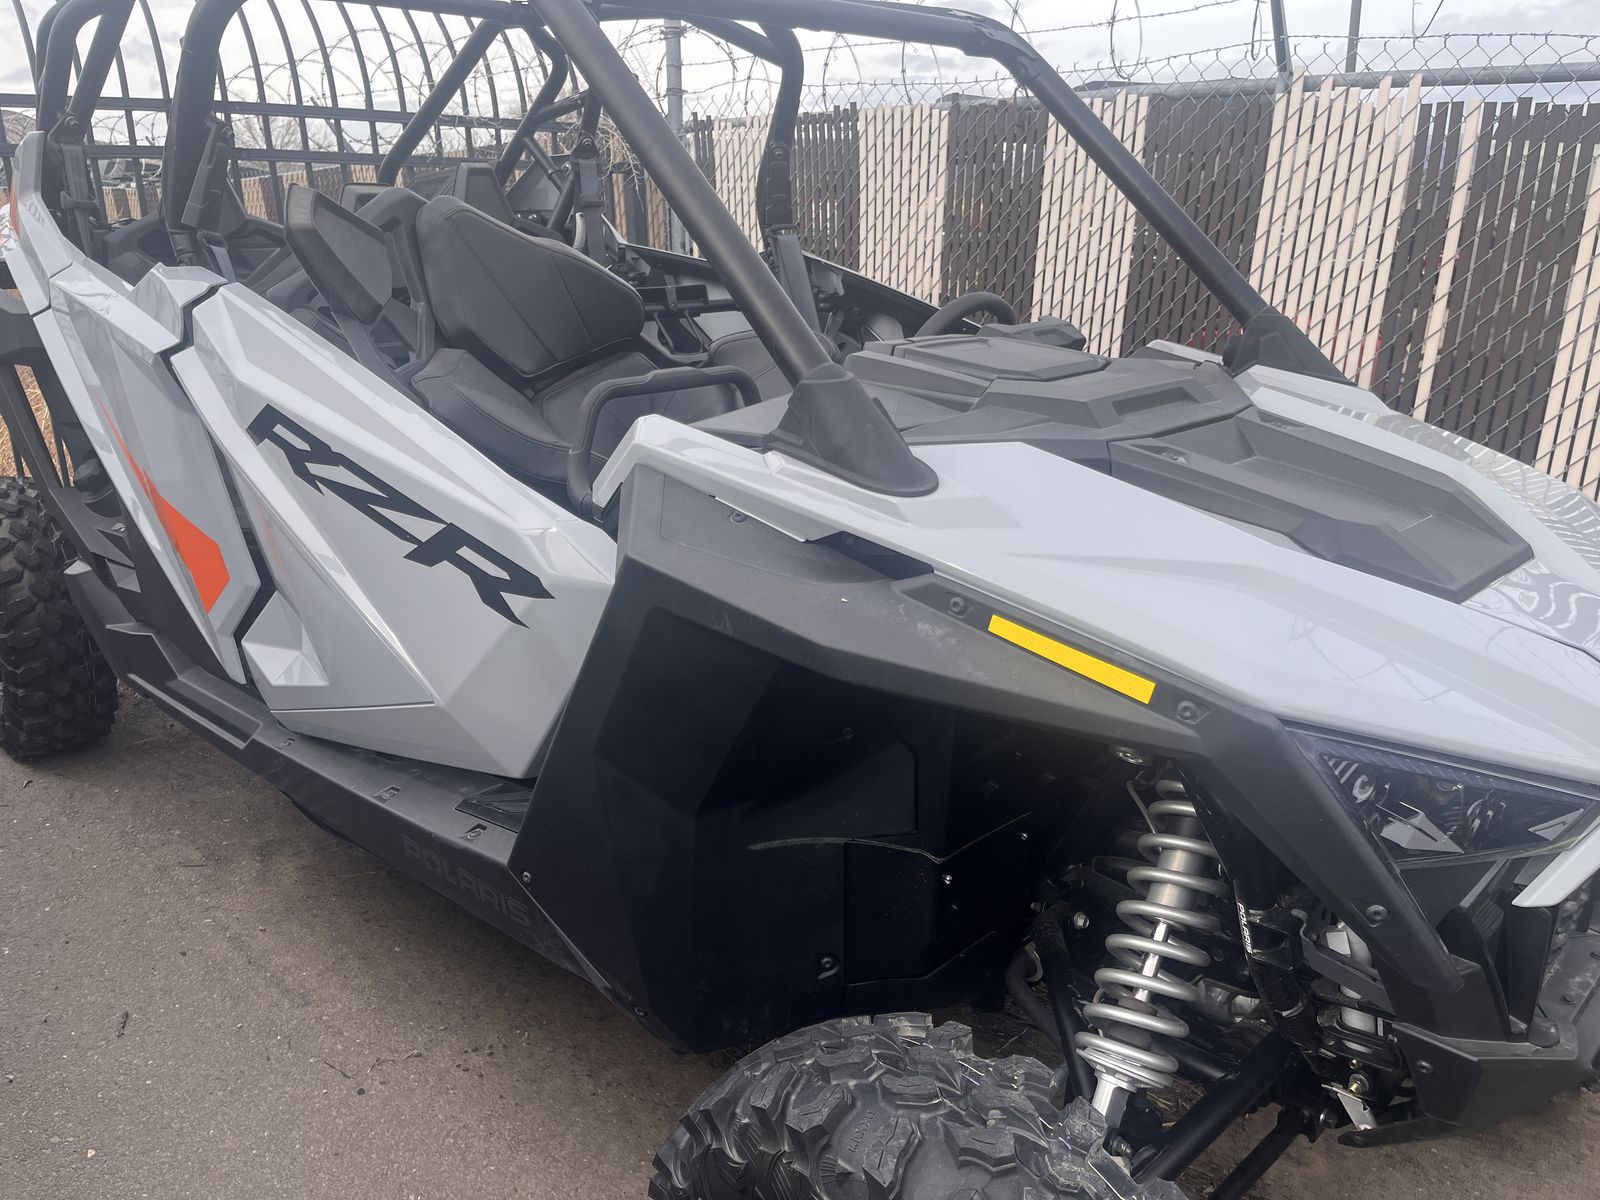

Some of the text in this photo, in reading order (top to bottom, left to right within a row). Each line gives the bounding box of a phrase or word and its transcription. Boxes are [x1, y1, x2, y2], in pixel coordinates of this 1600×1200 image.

[246, 403, 556, 629] RZR
[401, 833, 533, 928] POLARIS
[1237, 902, 1253, 954] POLARIS
